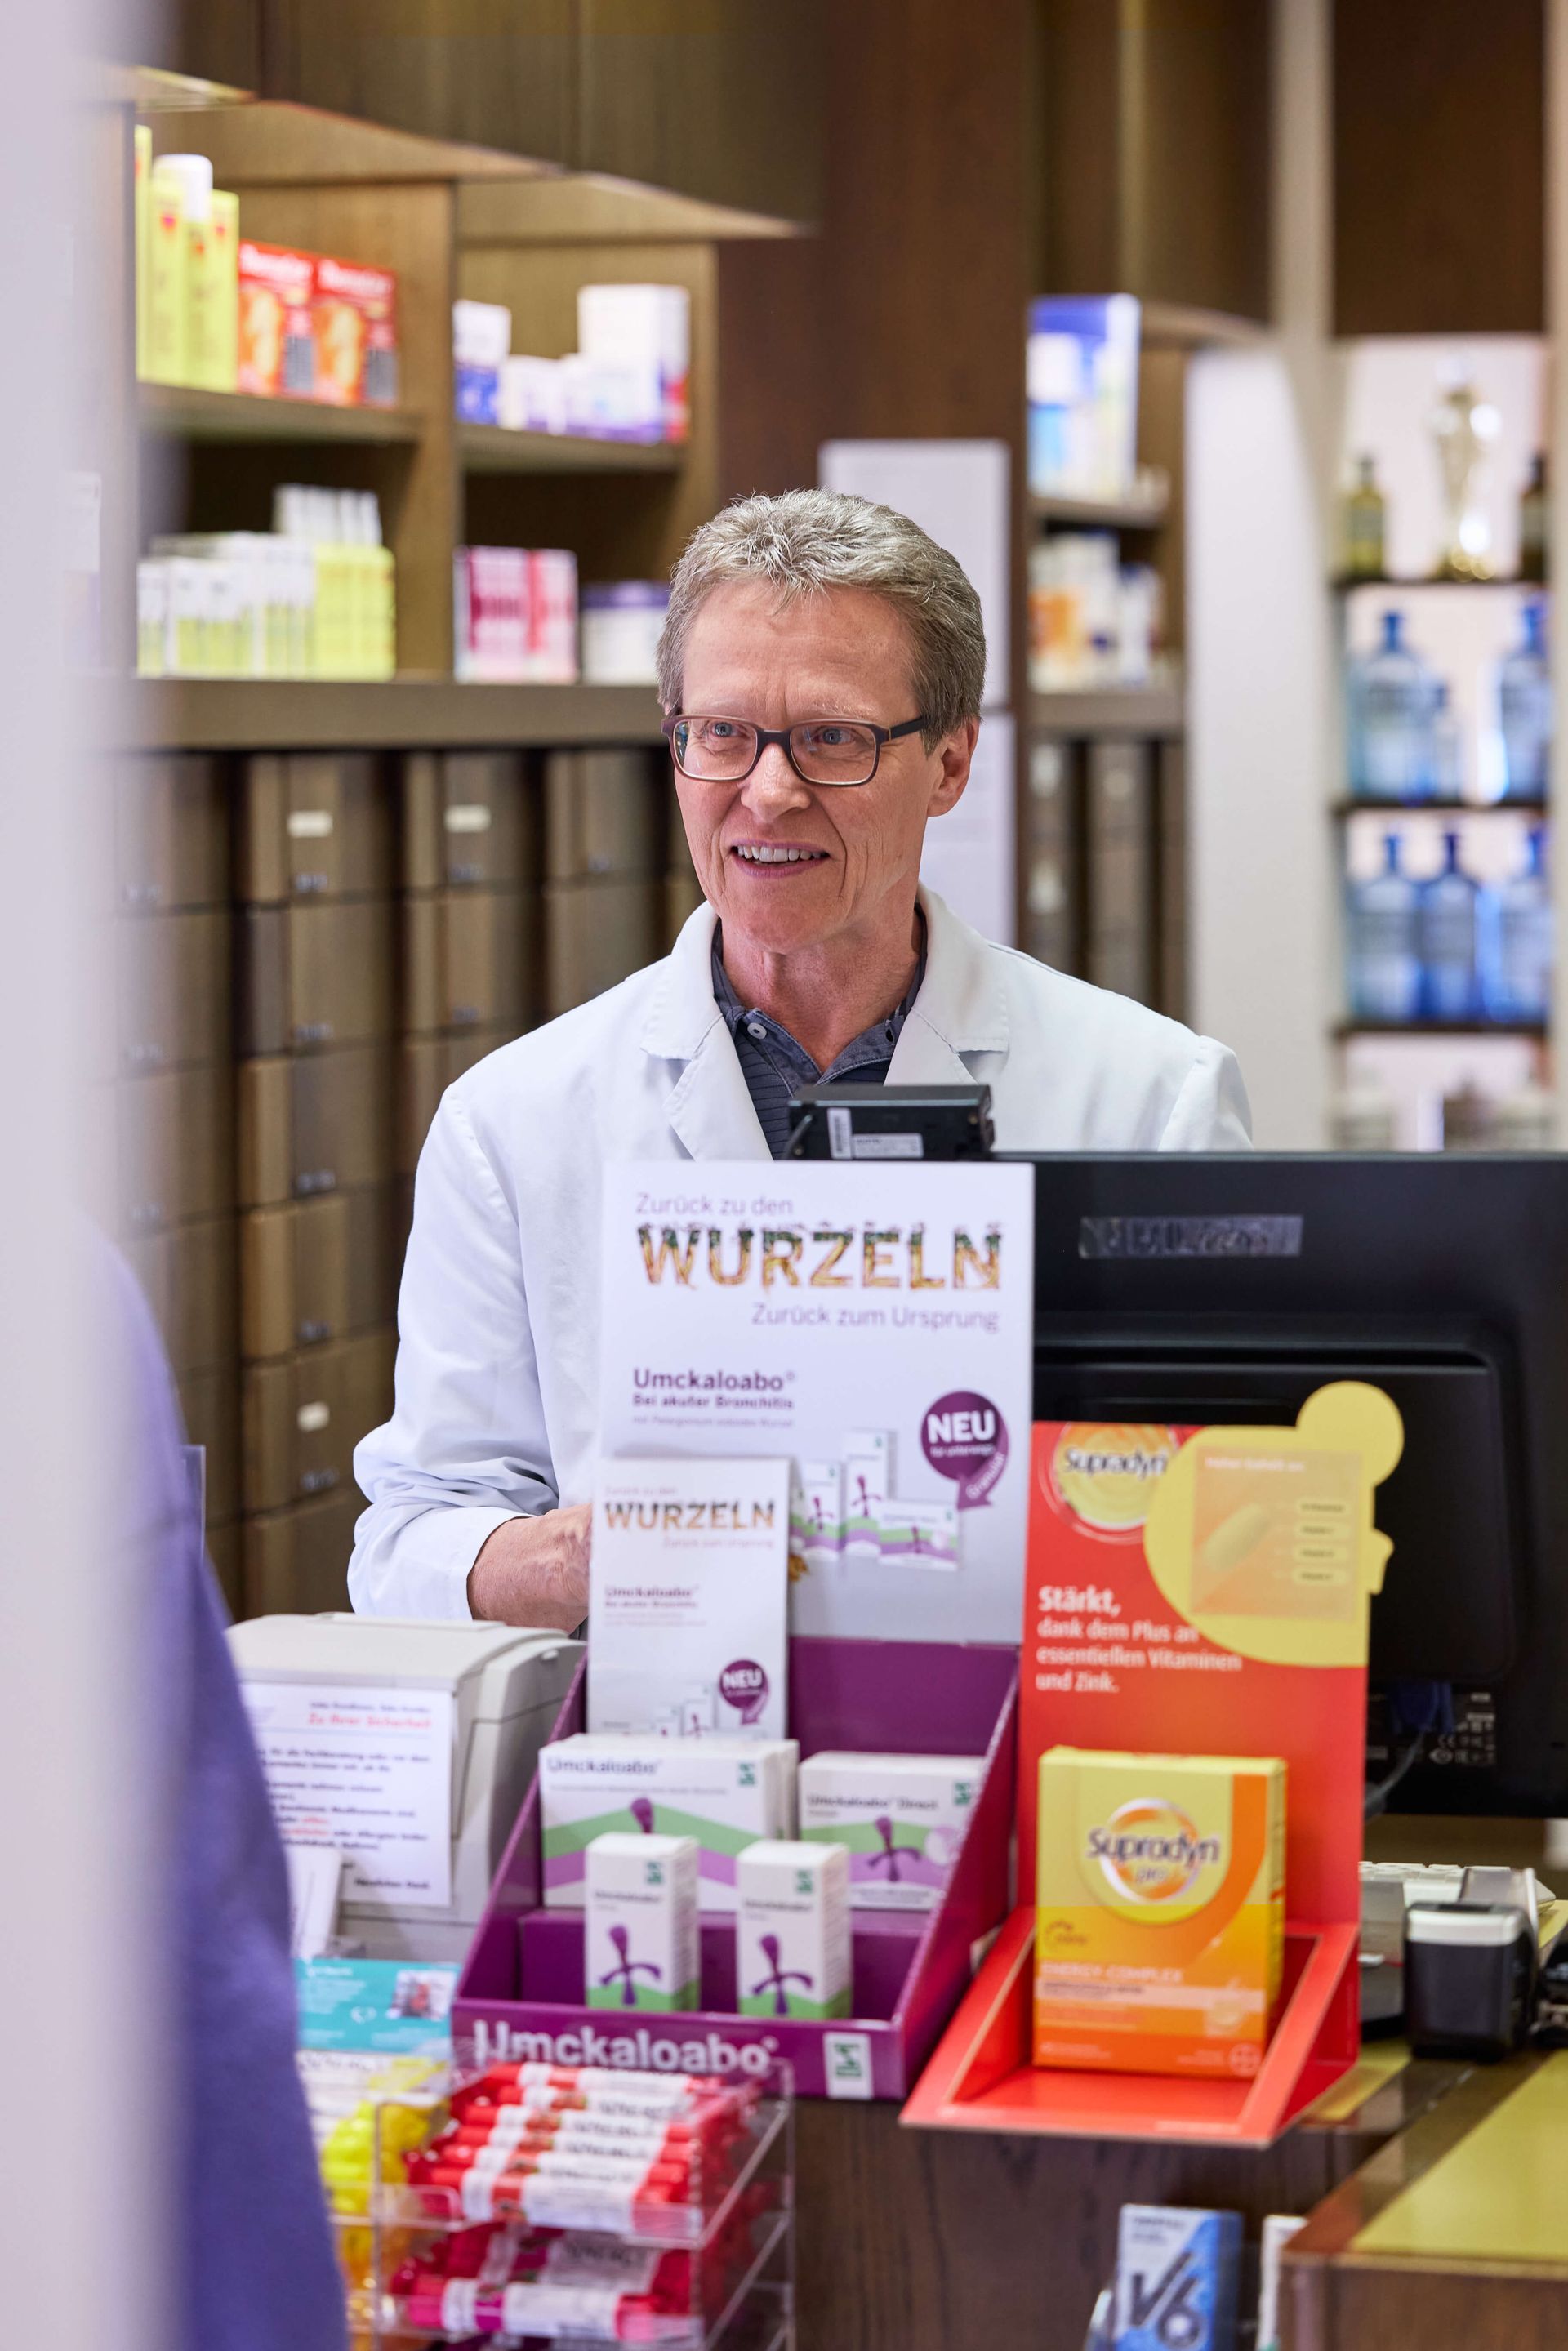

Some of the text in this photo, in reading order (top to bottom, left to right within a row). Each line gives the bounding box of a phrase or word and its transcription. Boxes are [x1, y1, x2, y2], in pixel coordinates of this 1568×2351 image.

[636, 1192, 794, 1216] Zurück zu den
[638, 1225, 1002, 1289] WURZELN
[751, 1302, 1000, 1334] Zurück zum Ursprung
[927, 1409, 996, 1445] NEU
[1065, 1446, 1169, 1481] Supradyn
[604, 1499, 775, 1531] WURZELN
[1038, 1585, 1121, 1617] Stärkt,
[1036, 1616, 1084, 1639] dank
[1086, 1617, 1129, 1641] dem
[1131, 1619, 1172, 1643] Plus
[1036, 1645, 1243, 1672] essentiellen Vitaminen
[722, 1668, 764, 1690] NEU
[1035, 1669, 1072, 1691] und
[1087, 1828, 1220, 1868] Supradyn
